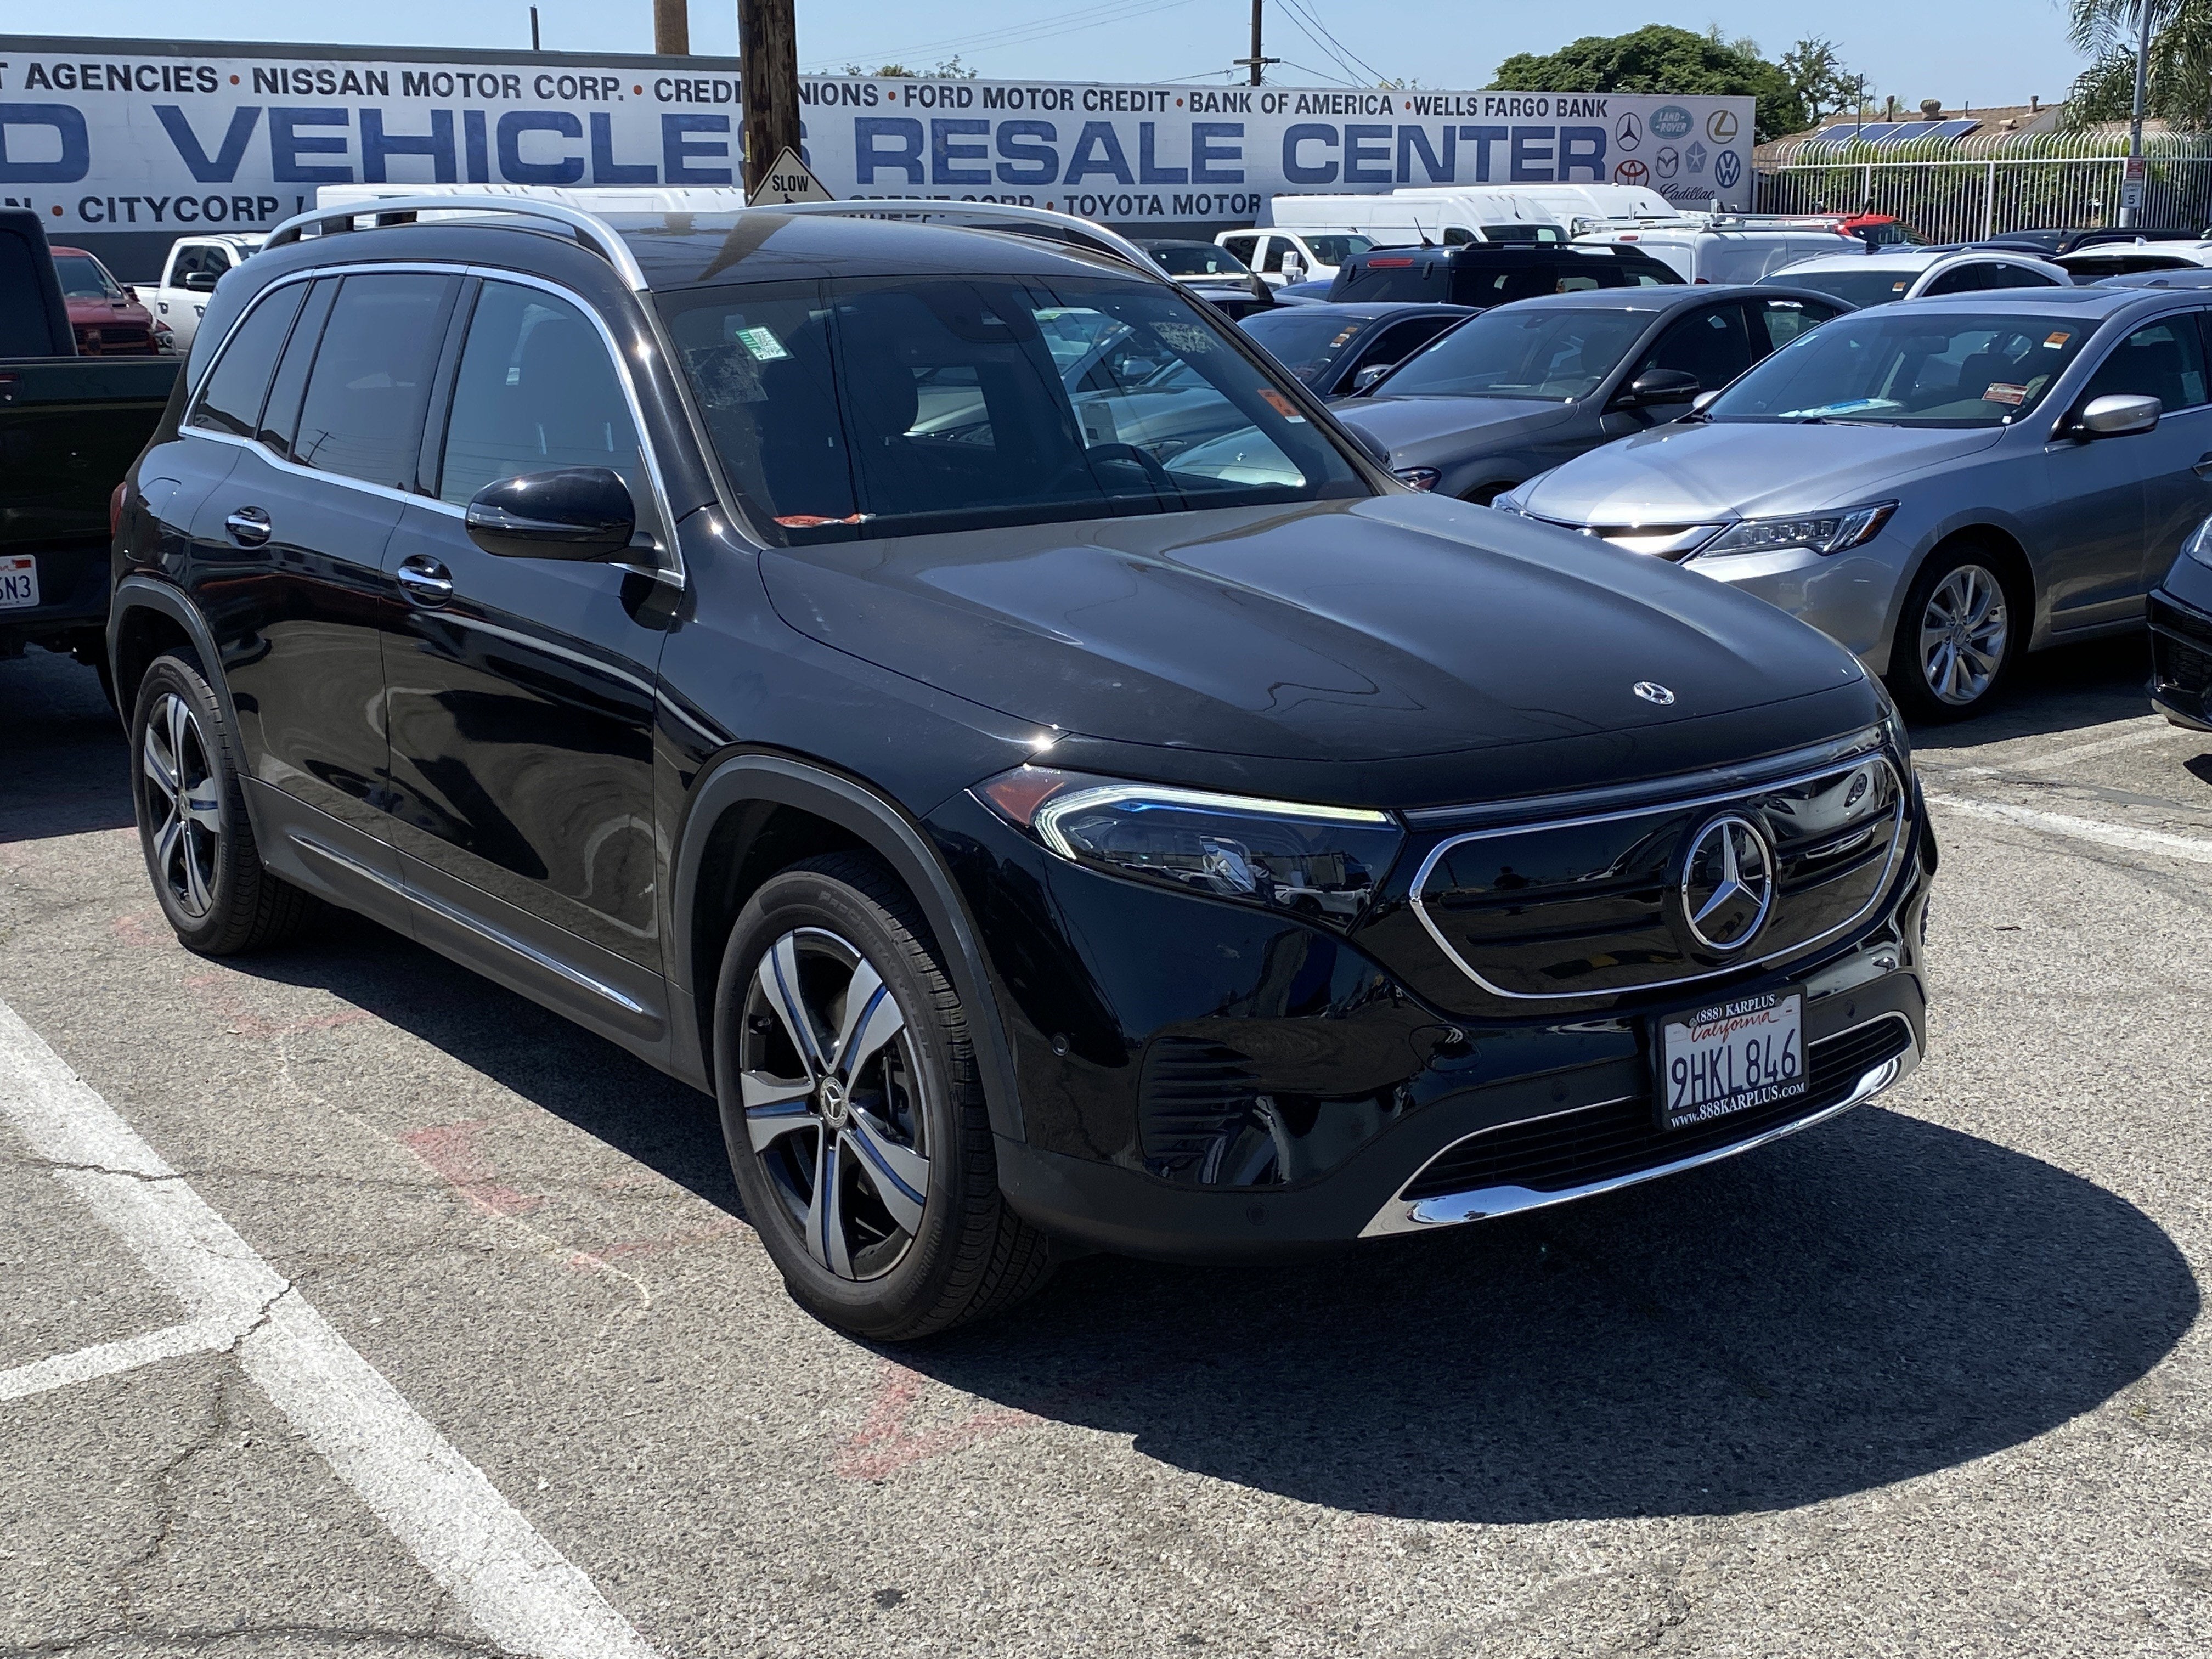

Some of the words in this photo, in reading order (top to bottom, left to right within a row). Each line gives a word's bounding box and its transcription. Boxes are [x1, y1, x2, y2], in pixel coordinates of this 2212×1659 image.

[25, 62, 218, 93] AGENCIES
[253, 67, 390, 97] NISSAN
[402, 70, 522, 99] MOTOR
[534, 75, 624, 101] CORP.
[654, 77, 742, 104] CREDI
[797, 82, 879, 108] NIONS
[904, 84, 973, 109] FORD
[983, 86, 1074, 111] MOTOR
[1082, 88, 1170, 112] CREDIT
[1189, 92, 1252, 113] BANK
[1262, 92, 1289, 114] OF
[1295, 93, 1393, 116] AMERICA
[1413, 95, 1478, 117] WELLS
[1485, 97, 1549, 118] FARGO
[1556, 99, 1608, 118] BANK
[1658, 112, 1680, 122] LAND
[1660, 122, 1686, 132] ROVER
[151, 104, 810, 185] VEHICLE
[854, 117, 1245, 185] RESALE
[1283, 123, 1607, 184] CENTER
[772, 174, 809, 192] SLOW
[1660, 182, 1715, 201] Cadillac
[78, 195, 279, 223] CITYCORP
[1063, 194, 1164, 216] TOYOTA
[1172, 193, 1261, 215] MOTOR
[2128, 195, 2135, 204] 5
[1696, 1007, 1722, 1023] (888)
[1725, 994, 1775, 1017] KARPLUS
[1691, 1011, 1780, 1043] California
[1671, 1028, 1796, 1109] 9HKL846
